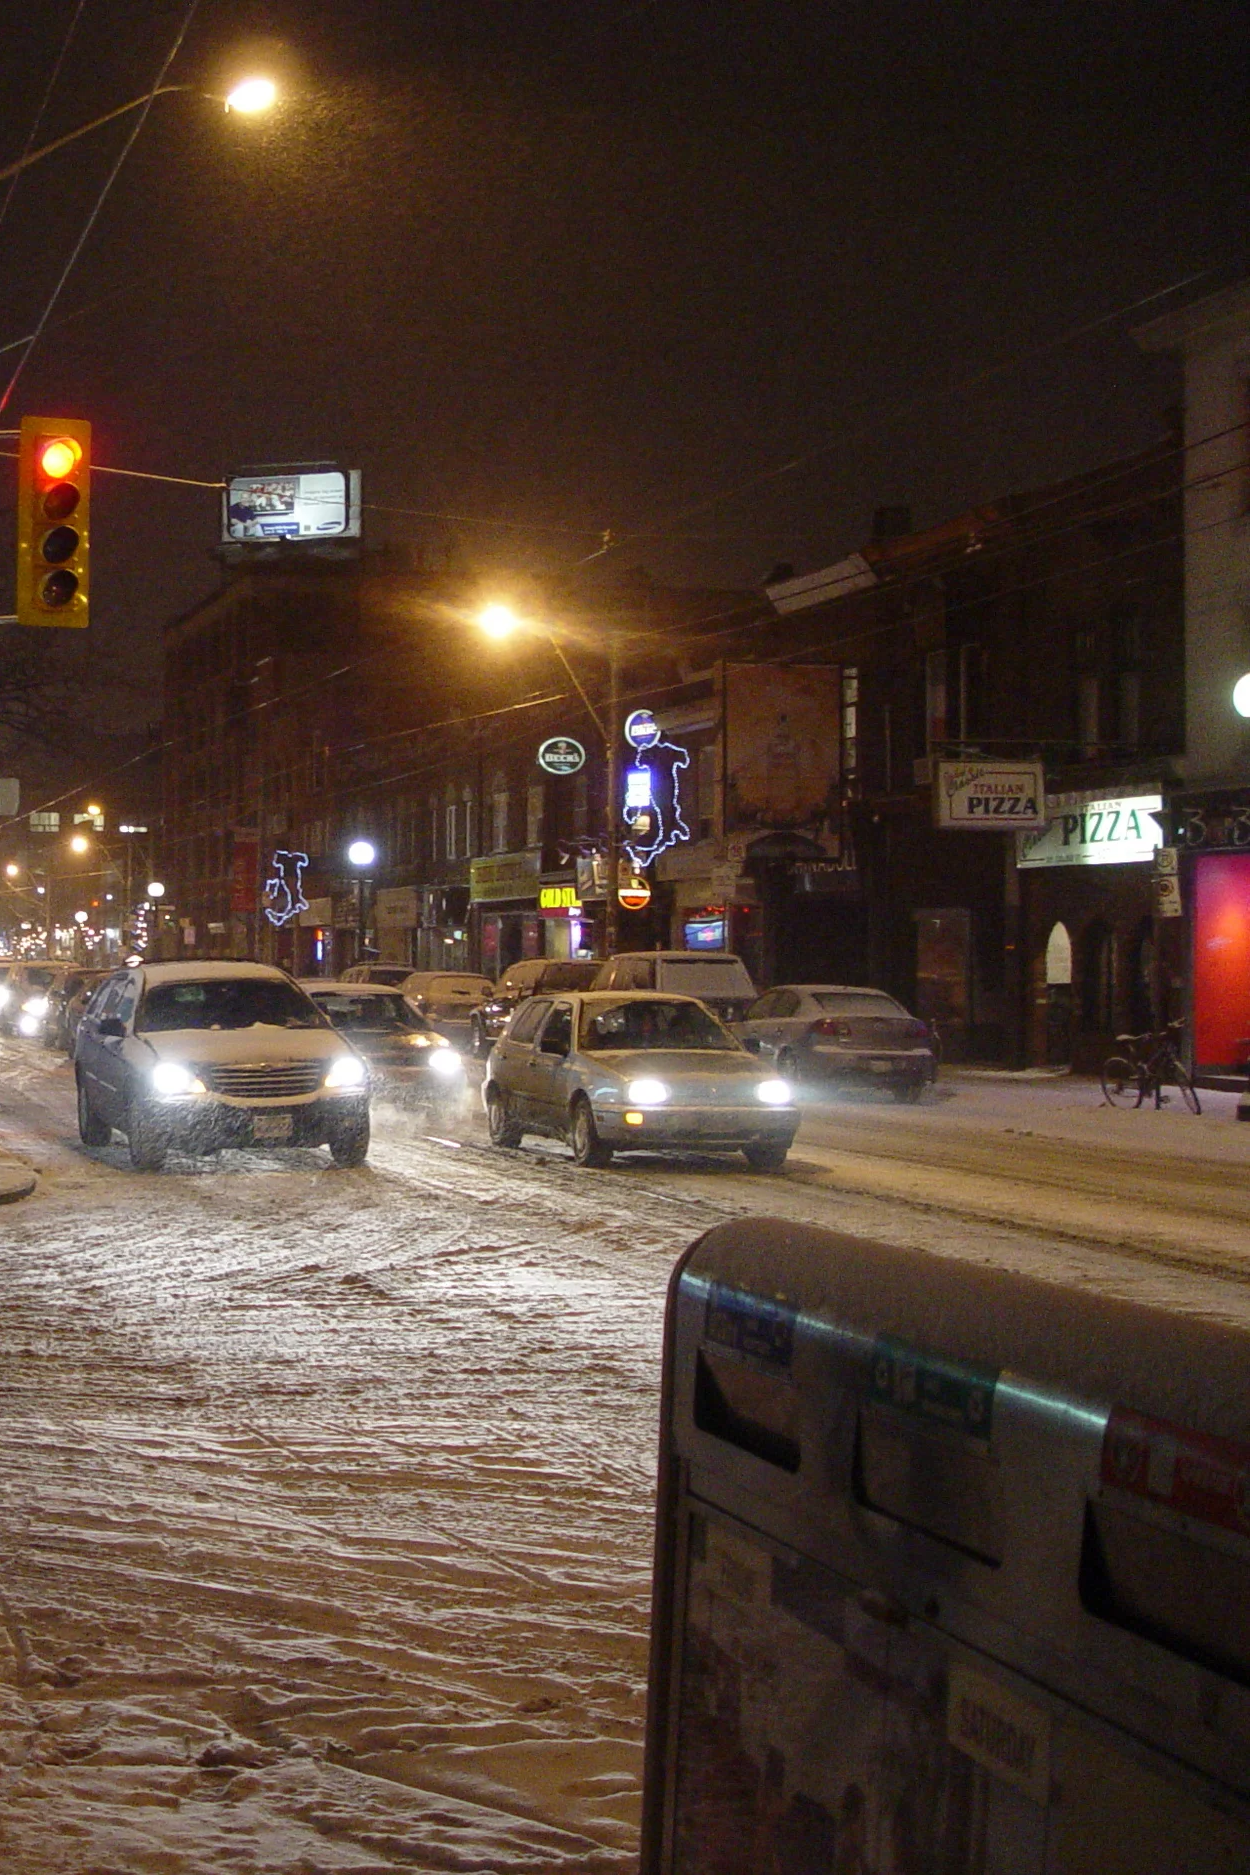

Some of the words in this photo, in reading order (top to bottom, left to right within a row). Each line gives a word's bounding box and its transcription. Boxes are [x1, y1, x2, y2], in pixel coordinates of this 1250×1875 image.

[973, 783, 1024, 795] ITALIAN
[967, 796, 1038, 815] PIZZA
[1061, 808, 1142, 846] PIZZA
